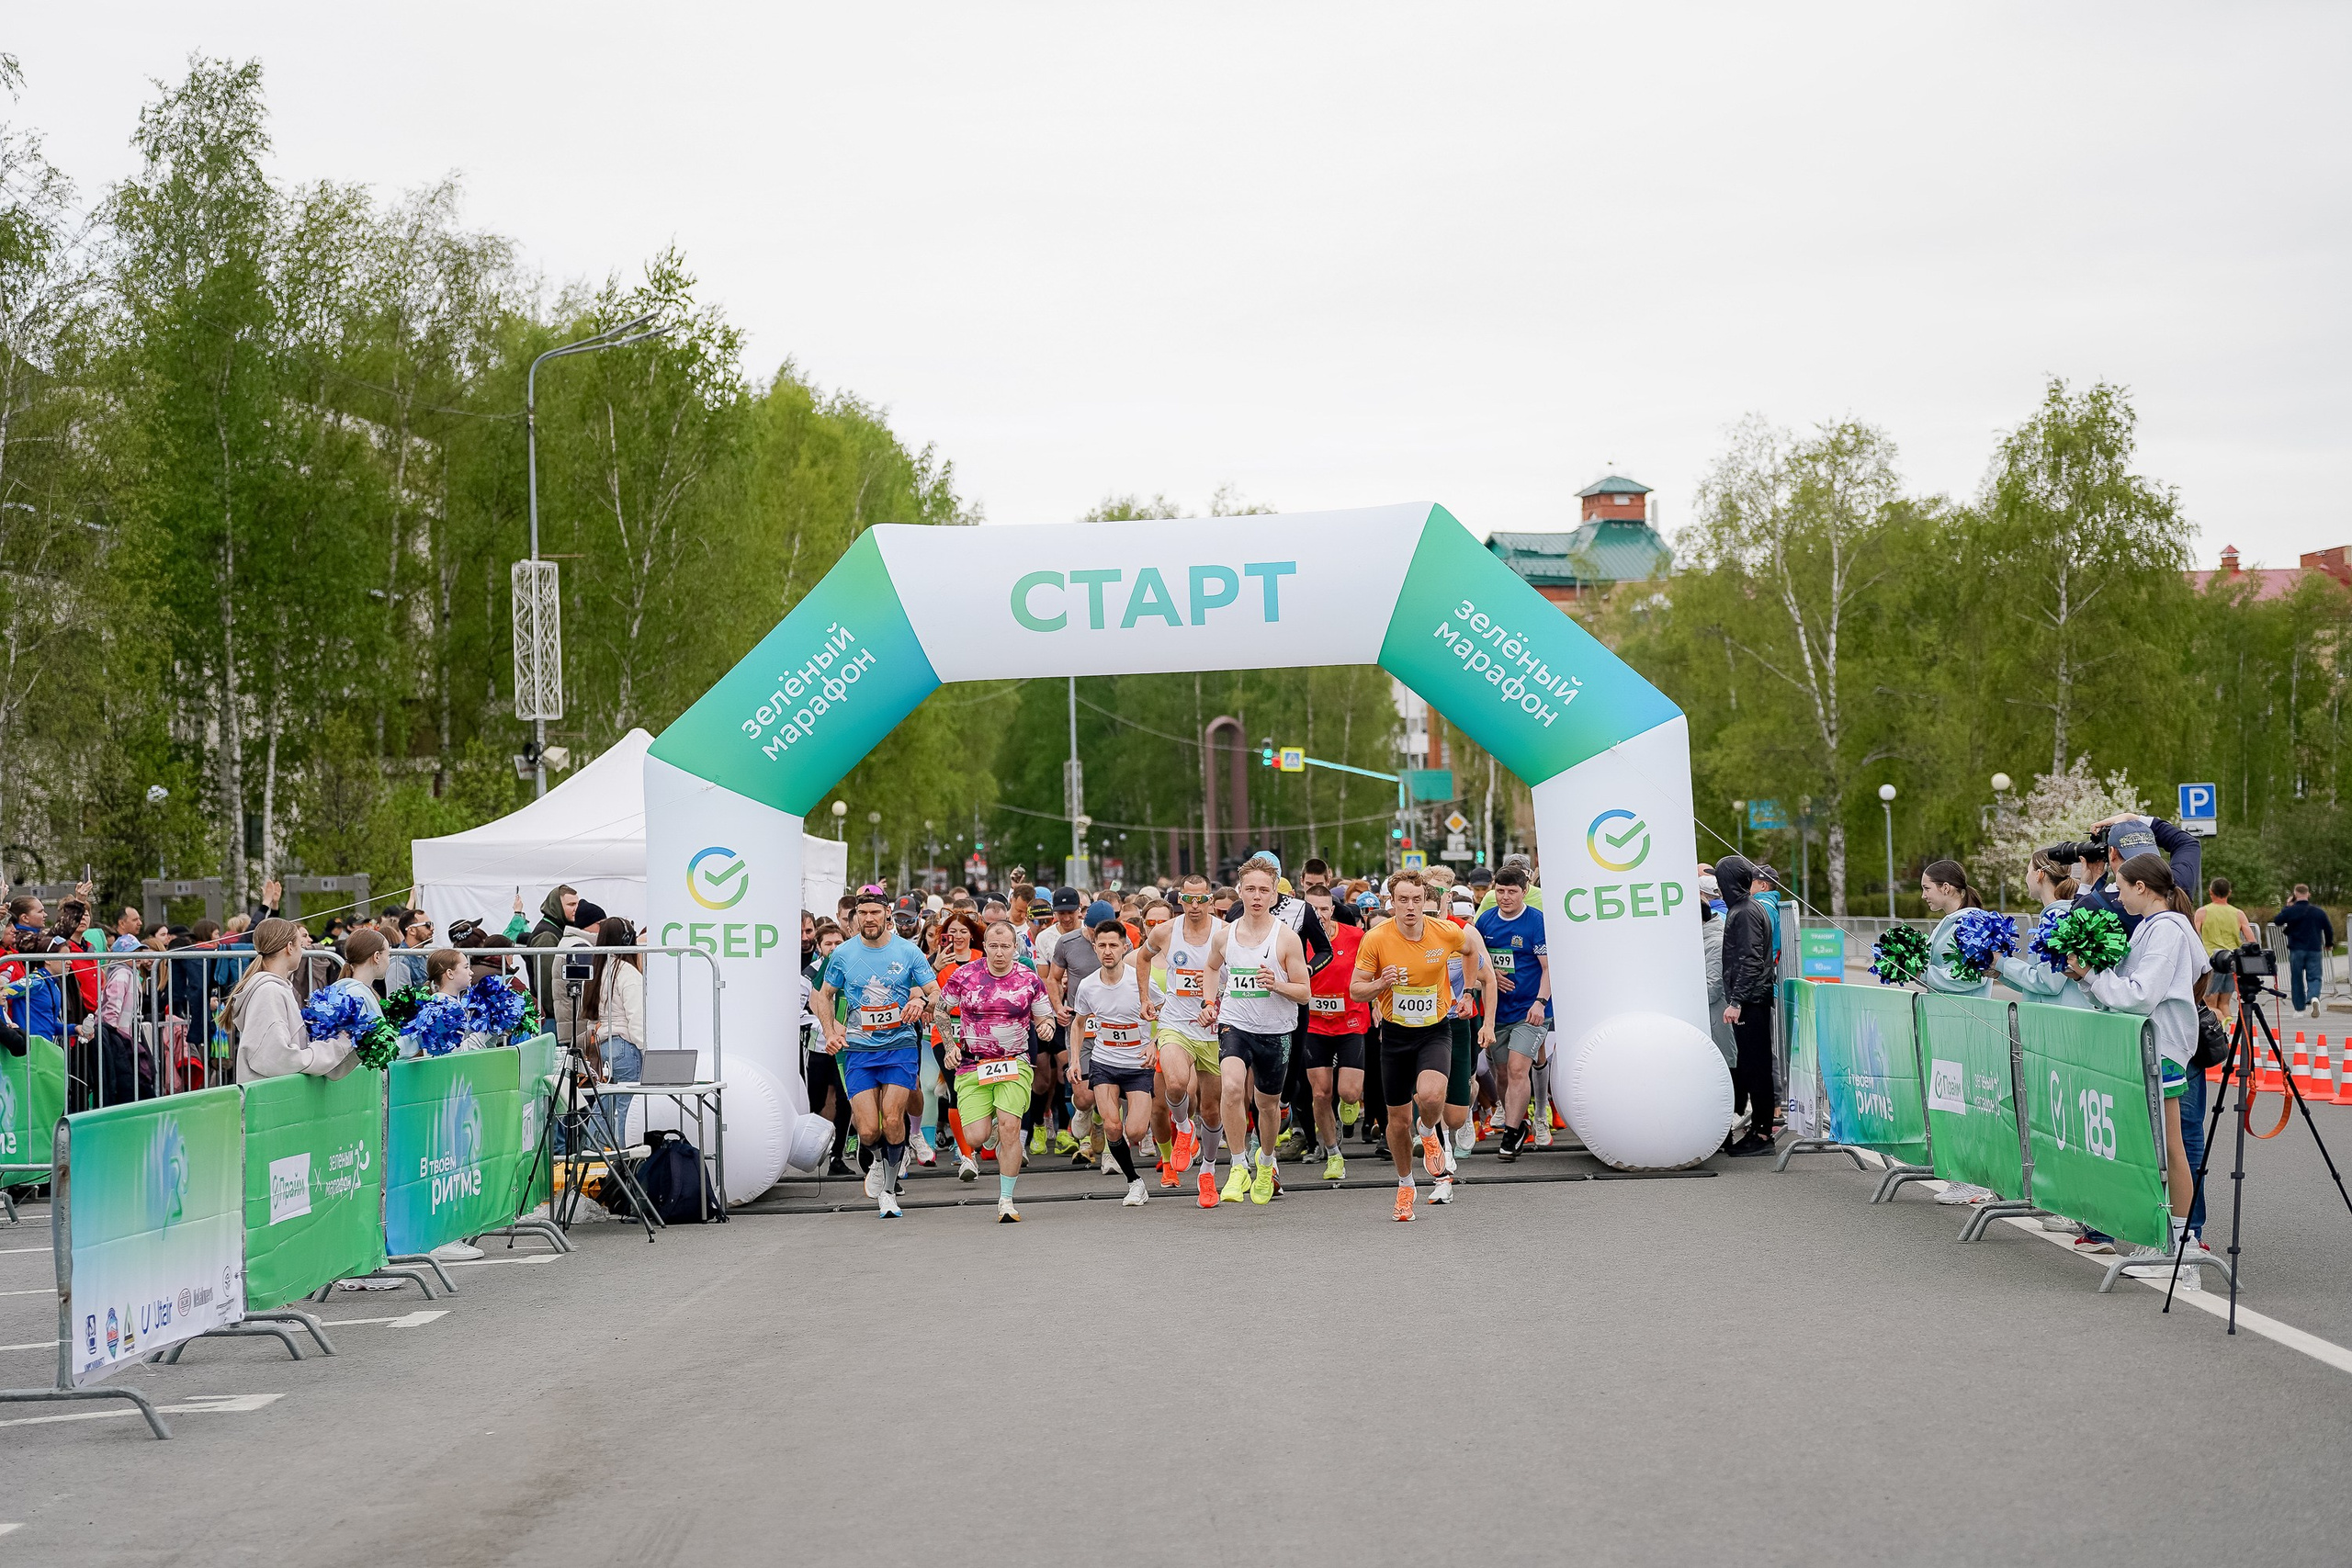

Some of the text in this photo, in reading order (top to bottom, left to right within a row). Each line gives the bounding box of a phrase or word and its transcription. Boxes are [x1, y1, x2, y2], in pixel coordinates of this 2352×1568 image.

[1011, 560, 1297, 633] СТАРТ
[1453, 599, 1584, 706] зелёный
[741, 621, 856, 740] зелёный
[1432, 621, 1559, 728] марафон
[761, 648, 877, 762] марафон
[2188, 787, 2210, 817] P
[1564, 881, 1684, 923] СБЕР
[661, 921, 779, 958] СБЕР
[1233, 976, 1266, 989] 141
[869, 1011, 893, 1023] 123
[1316, 999, 1338, 1010] 390
[1398, 998, 1432, 1011] 4003
[1113, 1031, 1127, 1040] 81
[985, 1063, 1009, 1076] 241
[2079, 1089, 2117, 1161] 185
[420, 1150, 457, 1178] В твоём
[431, 1168, 481, 1215] ритме
[153, 1296, 173, 1330] Utair
